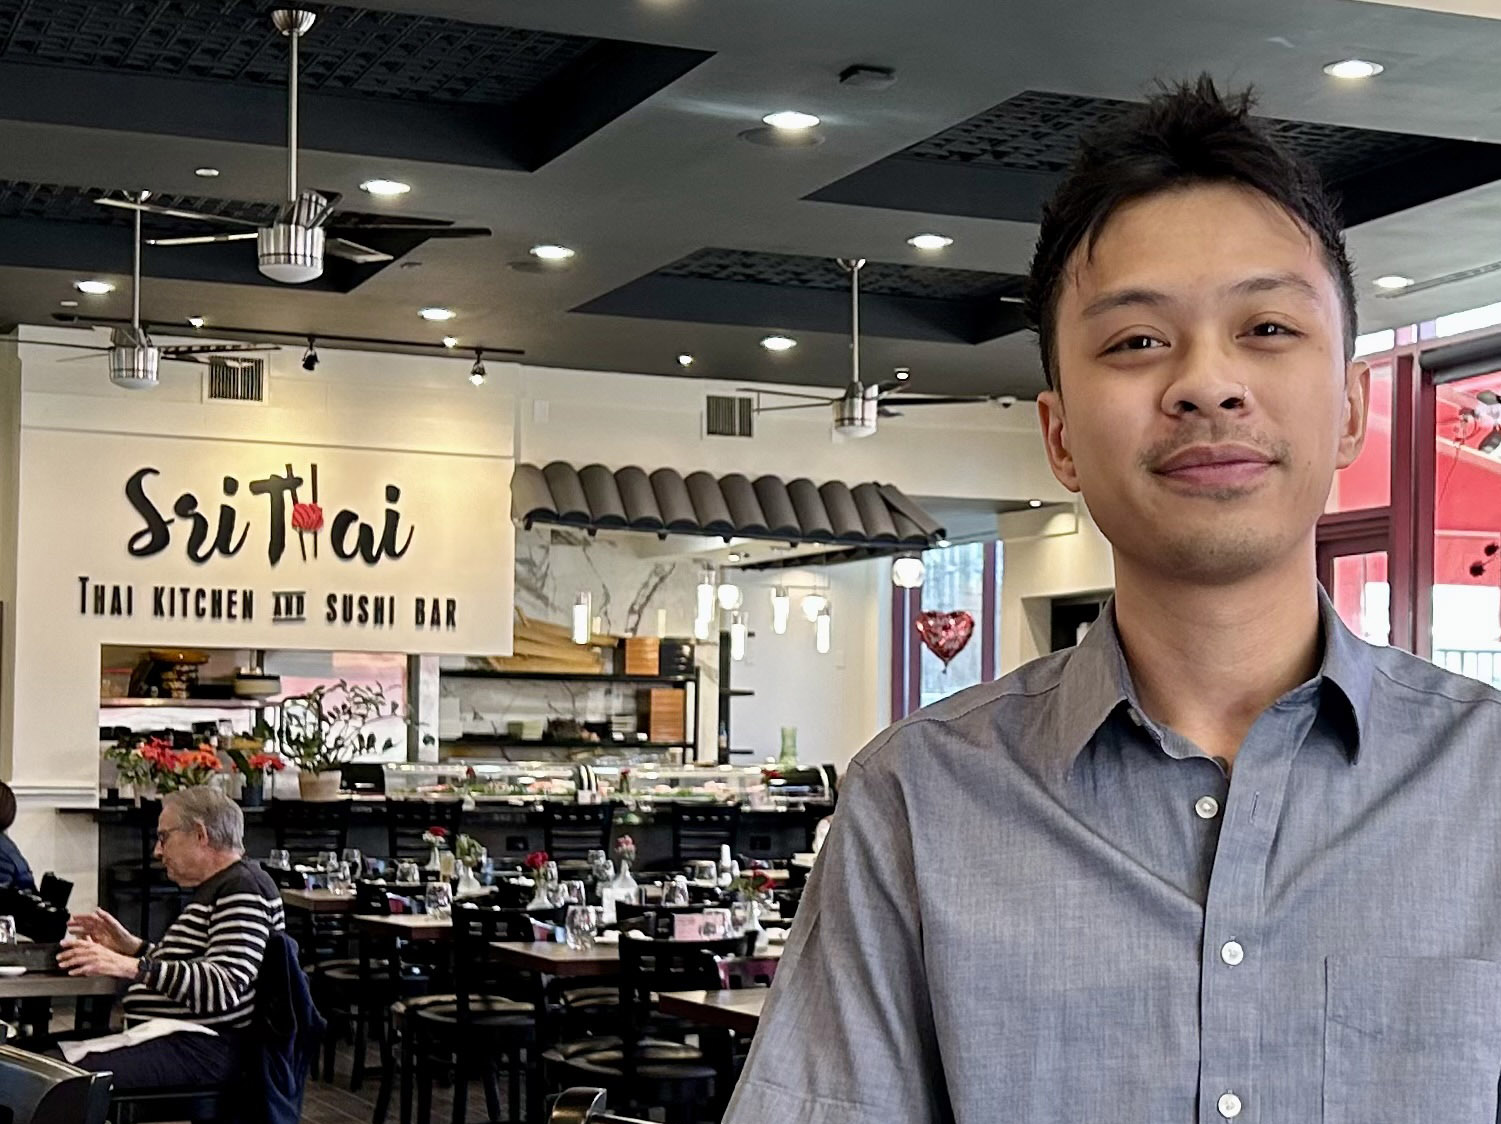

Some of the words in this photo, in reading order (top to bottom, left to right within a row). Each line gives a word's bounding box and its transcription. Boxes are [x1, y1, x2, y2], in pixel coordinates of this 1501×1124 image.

[153, 586, 254, 621] KITCHEN
[271, 593, 306, 619] AND
[325, 593, 395, 626] SUSHI
[414, 597, 457, 629] BAR
